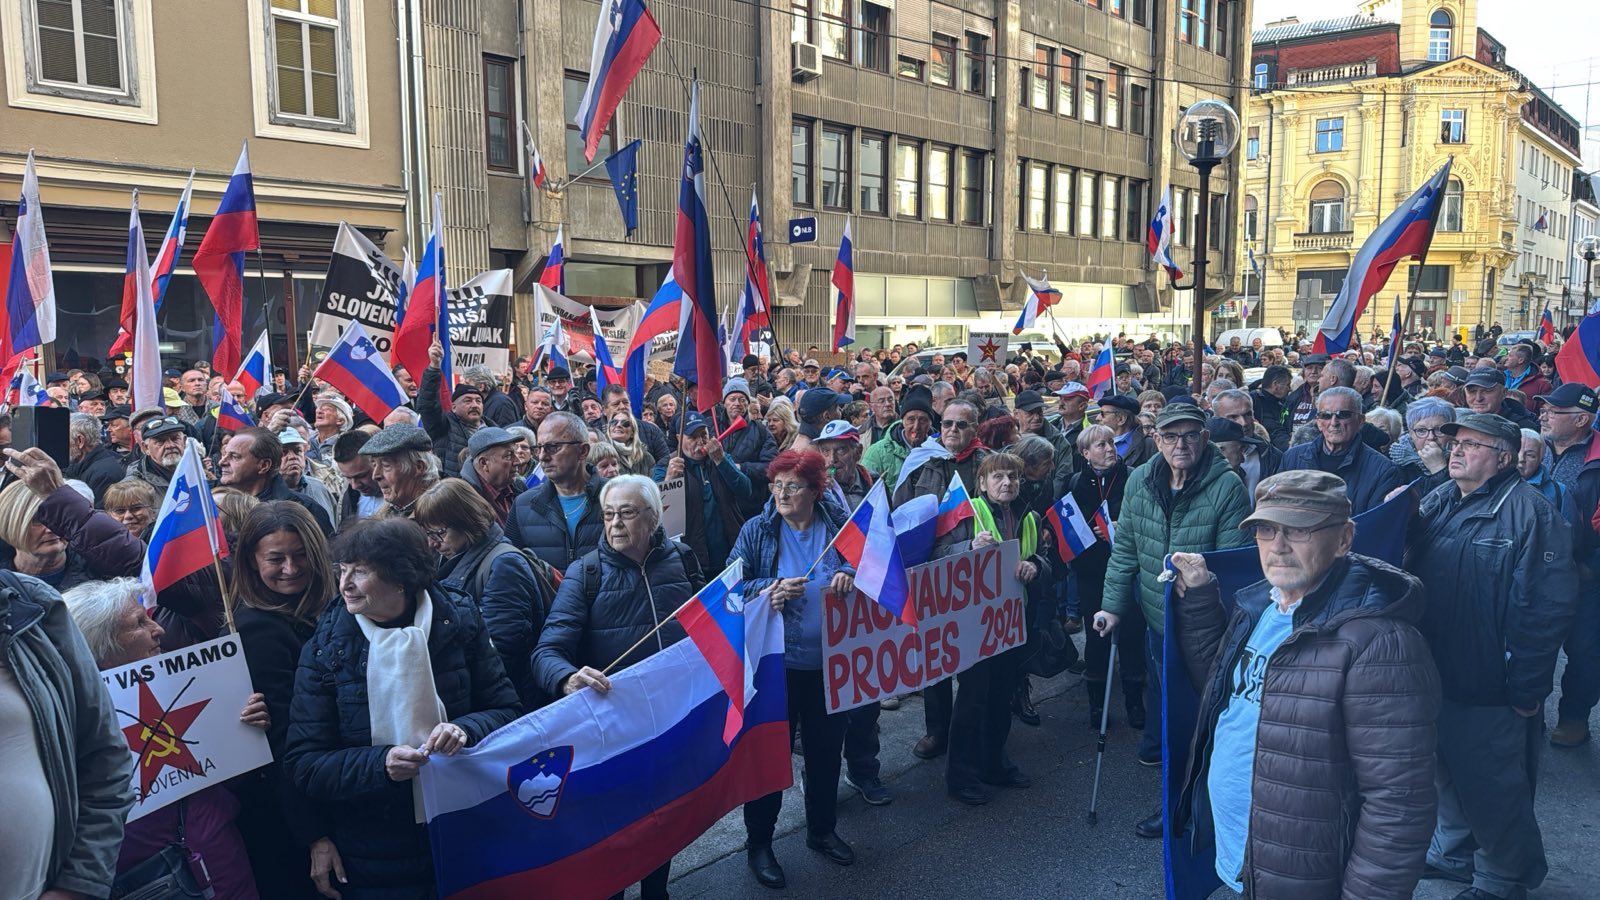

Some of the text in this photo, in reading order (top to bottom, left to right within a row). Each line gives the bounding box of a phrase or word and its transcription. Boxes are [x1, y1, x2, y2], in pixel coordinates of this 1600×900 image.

[448, 308, 487, 325] NŠA
[828, 598, 1025, 710] PROCES 2024
[114, 664, 156, 690] VAS
